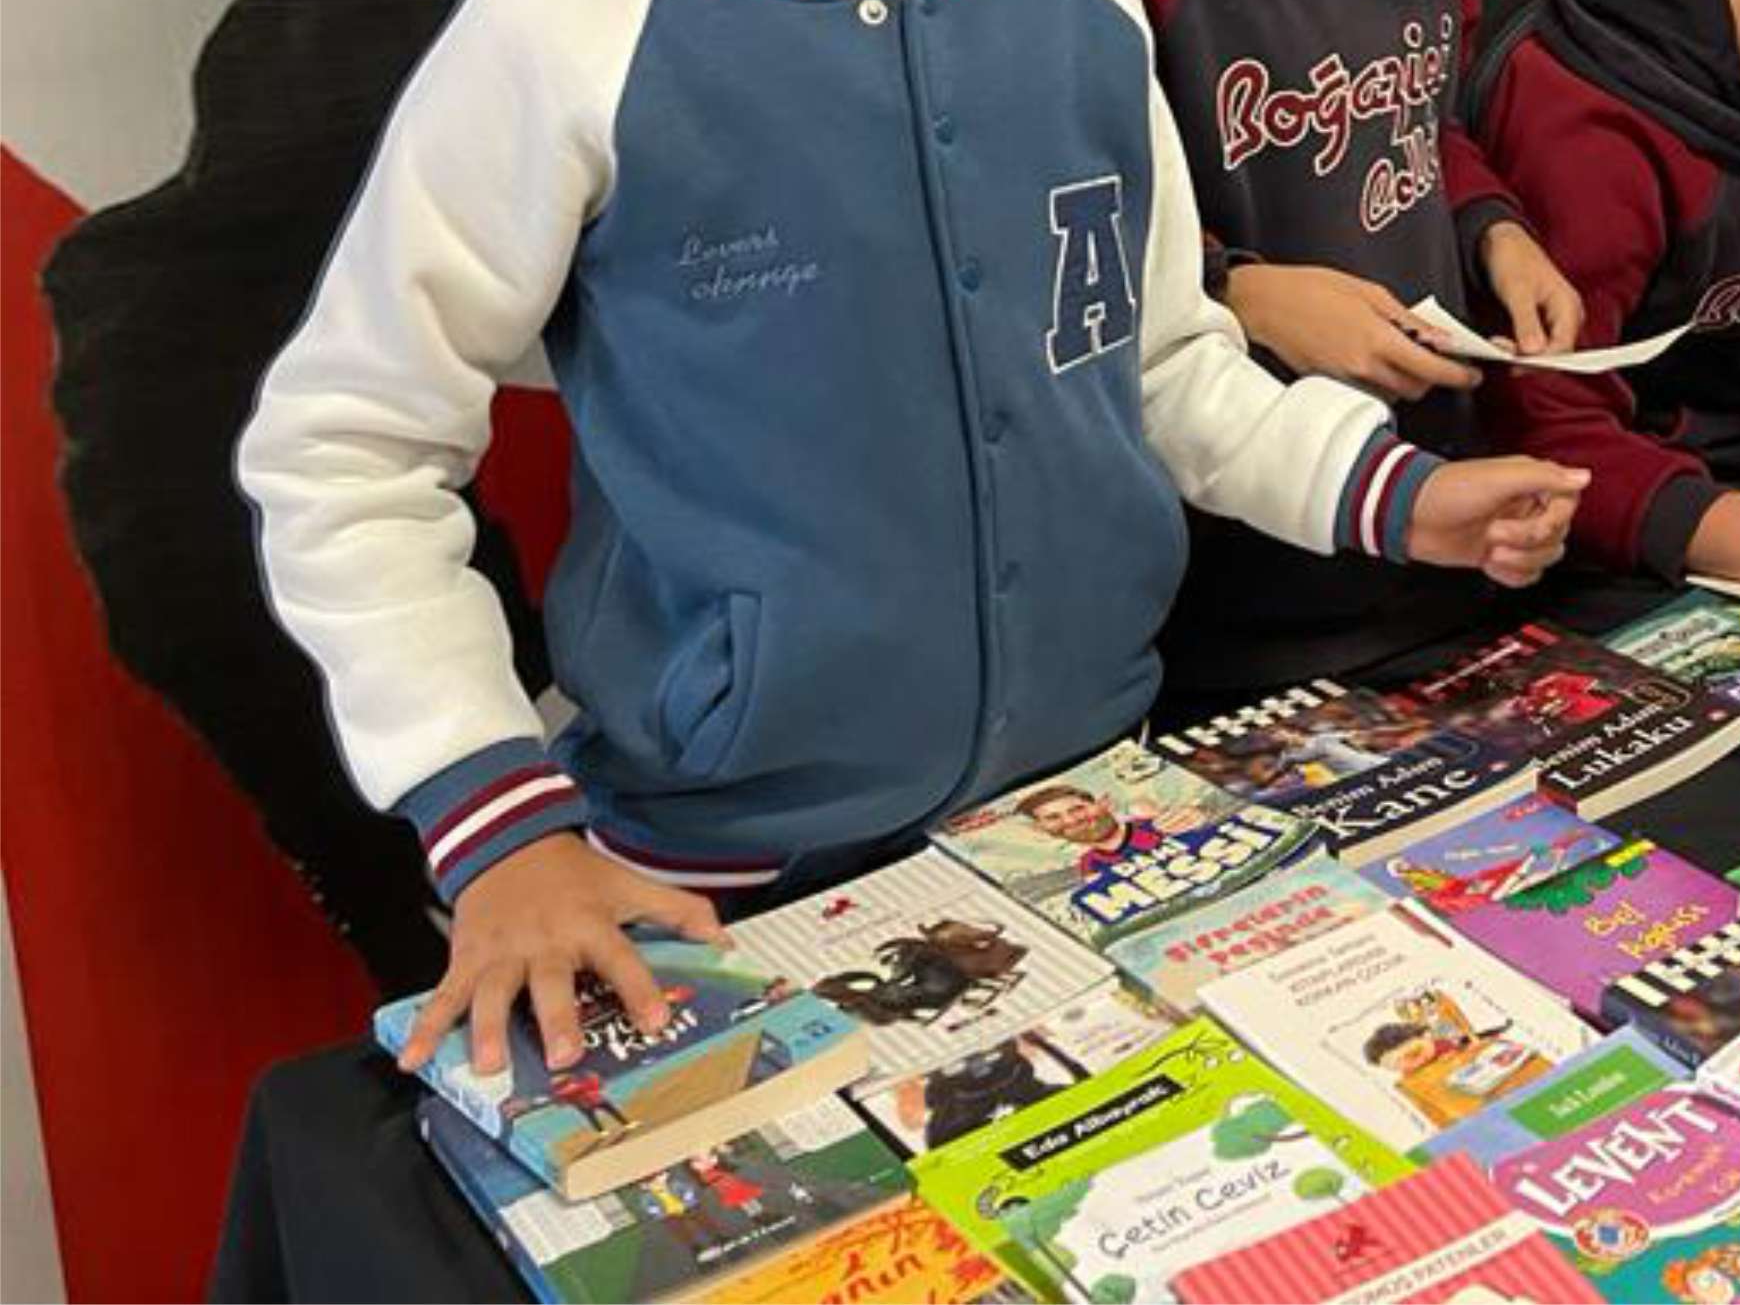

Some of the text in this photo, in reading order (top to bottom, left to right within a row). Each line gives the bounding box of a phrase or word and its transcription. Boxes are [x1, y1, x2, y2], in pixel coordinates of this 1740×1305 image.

[1047, 174, 1137, 374] A
[1549, 716, 1695, 789] Lukaku
[1313, 770, 1479, 839] Kane
[1080, 821, 1275, 923] MESSİ
[1021, 1132, 1070, 1161] Eda
[1514, 1097, 1719, 1218] LEVENT
[1097, 1204, 1194, 1260] Çetin
[1194, 1159, 1293, 1211] Ceviz
